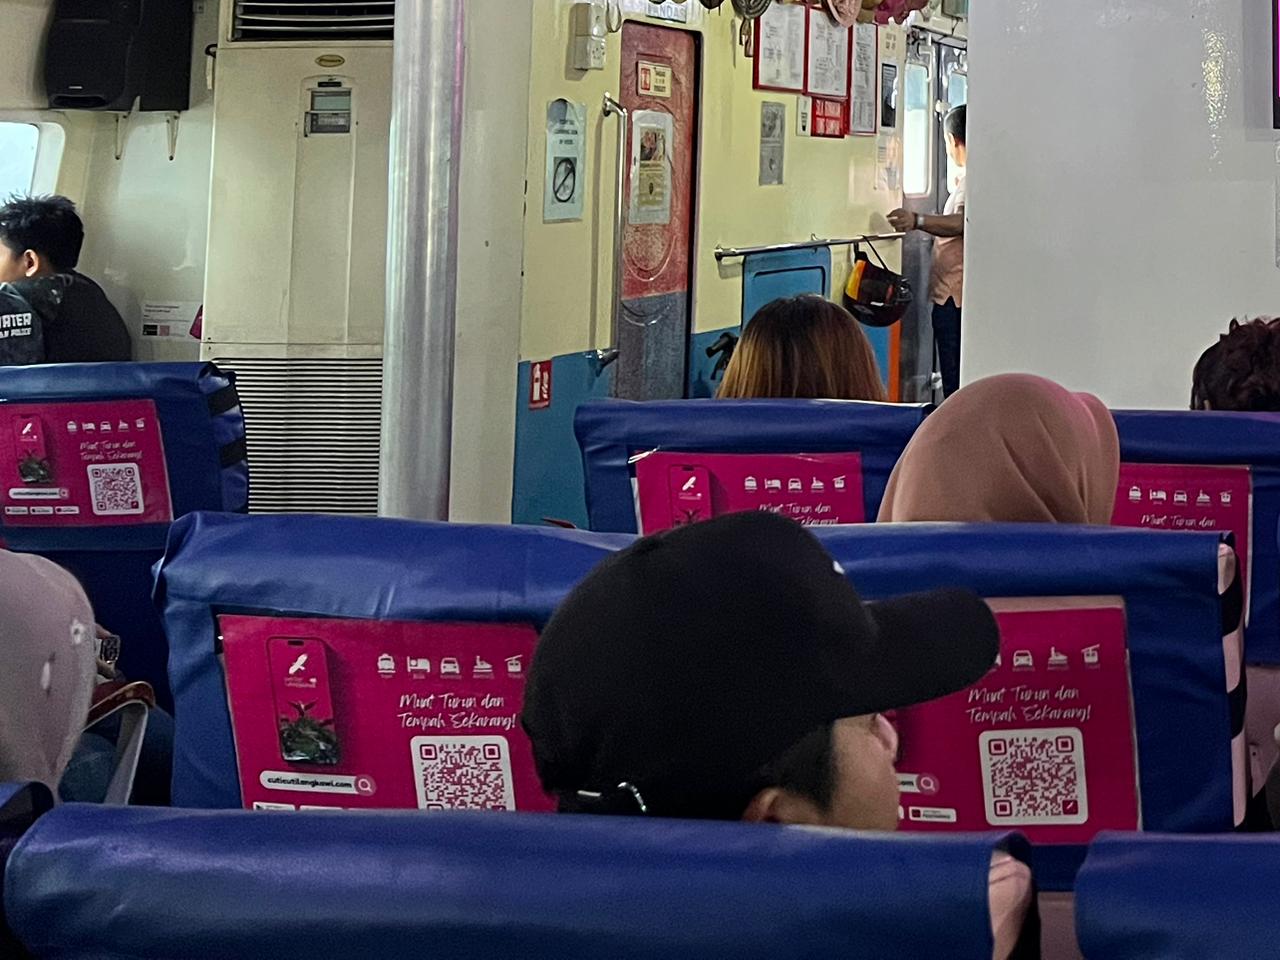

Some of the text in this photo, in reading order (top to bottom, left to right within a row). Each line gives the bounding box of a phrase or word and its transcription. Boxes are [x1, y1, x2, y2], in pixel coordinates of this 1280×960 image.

[0, 313, 31, 328] ATER
[400, 692, 505, 709] Muat Turun dan
[968, 685, 1079, 703] Muat Turun dan
[397, 712, 517, 731] Tempah Sekarang!
[966, 704, 1091, 725] Tempah Sekarang!
